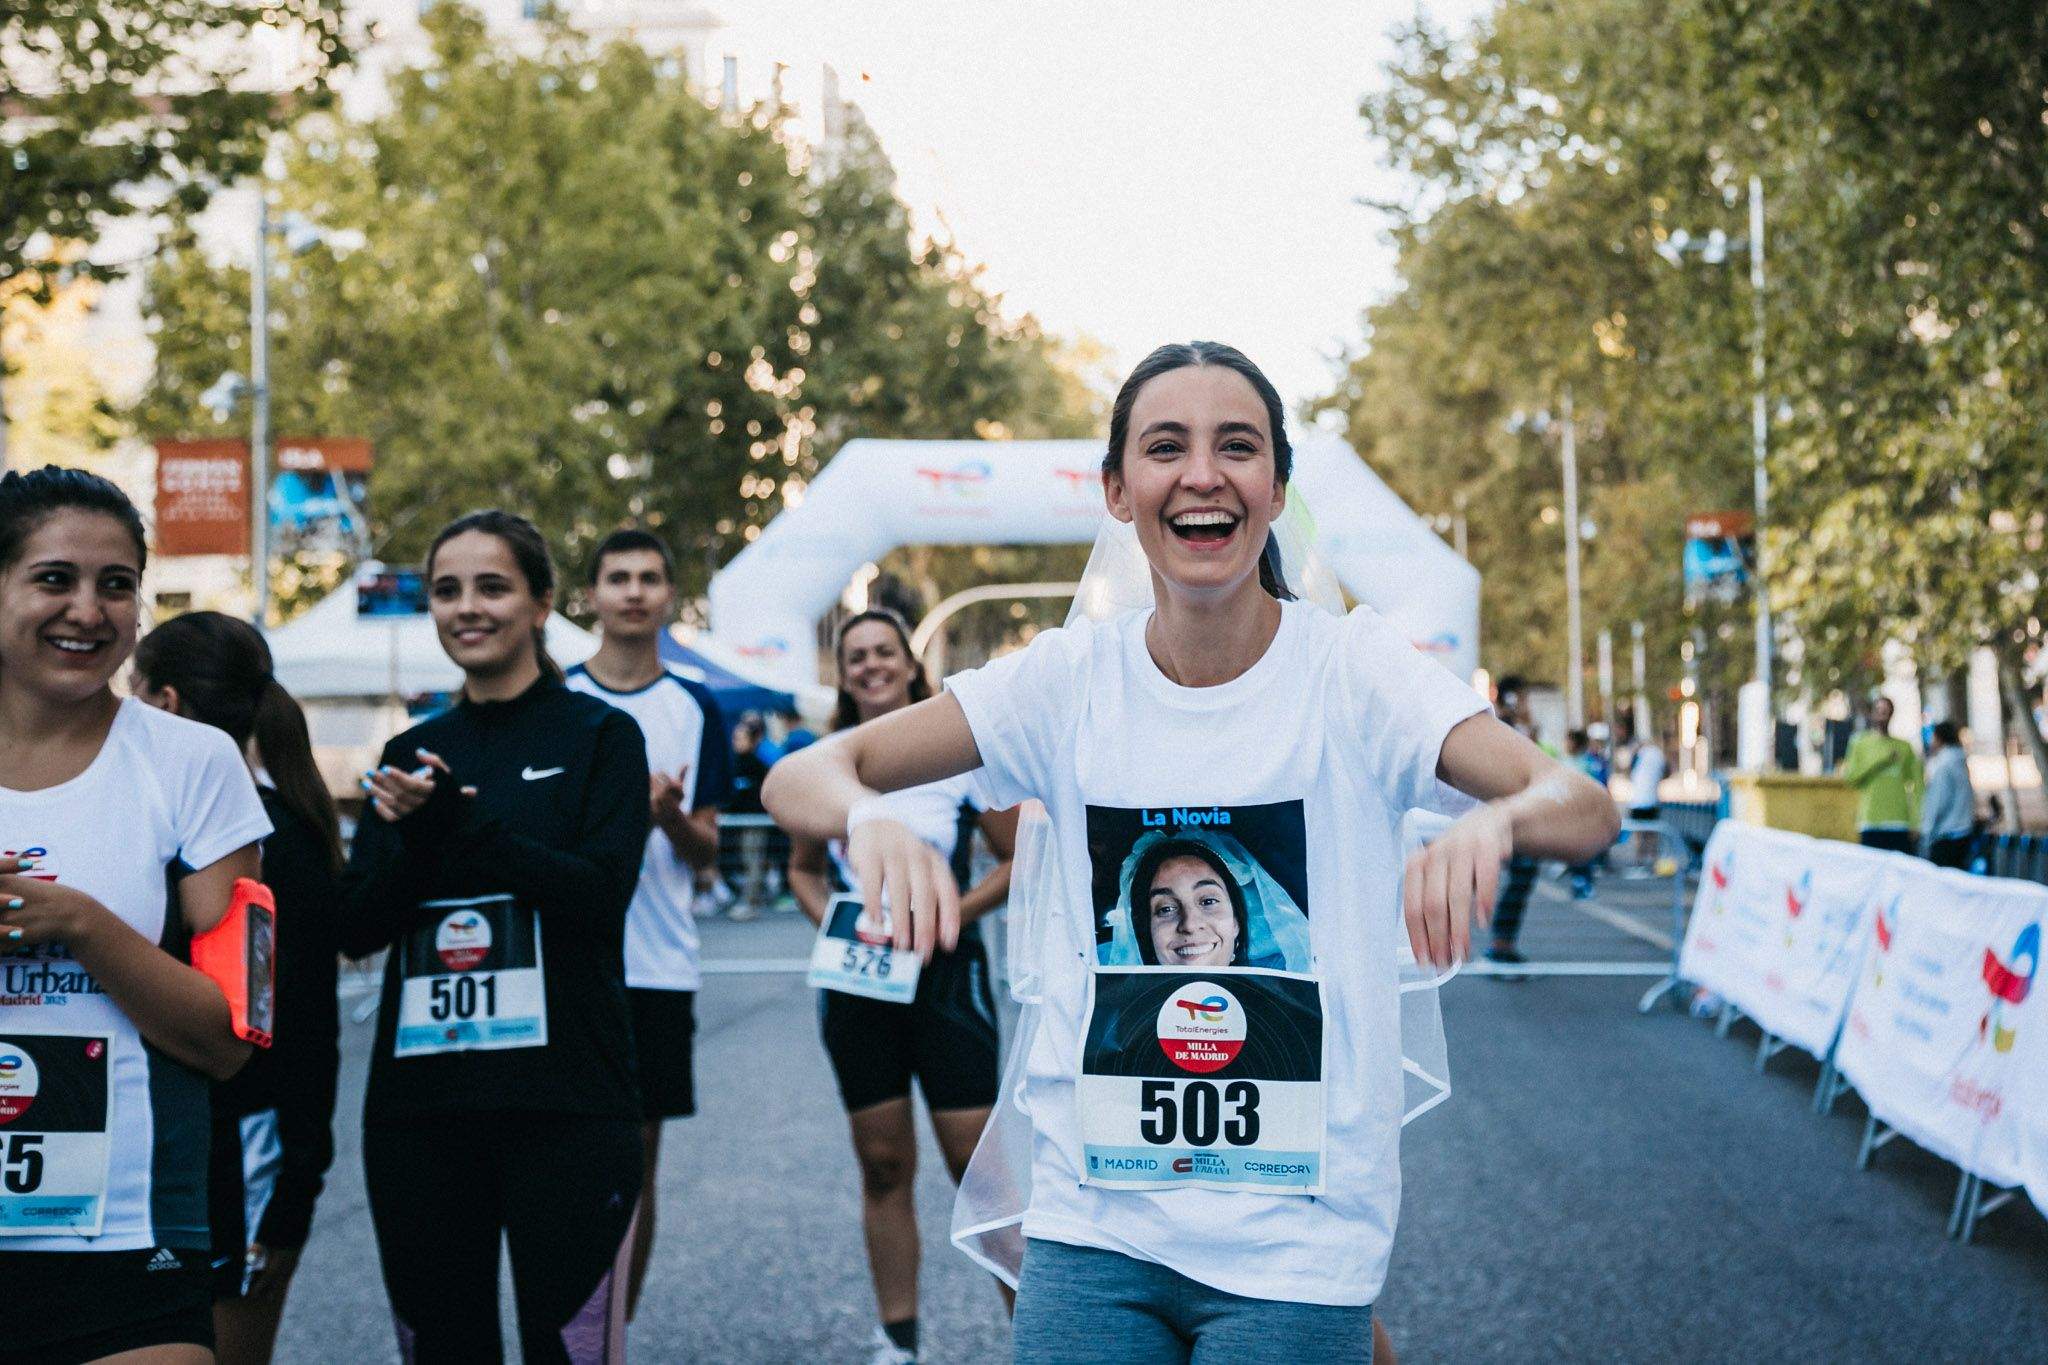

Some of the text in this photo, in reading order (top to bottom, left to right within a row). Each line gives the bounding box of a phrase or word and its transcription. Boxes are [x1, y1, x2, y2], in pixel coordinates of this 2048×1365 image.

[1142, 806, 1231, 827] La Novia
[431, 974, 496, 1021] 501
[1175, 1025, 1229, 1035] TotalEnergies
[1187, 1042, 1217, 1051] MILLA
[1175, 1051, 1229, 1061] DE MADRID
[1140, 1080, 1261, 1147] 503
[0, 1135, 44, 1193] 5
[1104, 1158, 1159, 1171] MADRID
[1194, 1157, 1226, 1166] MILLA
[1194, 1165, 1231, 1176] URBANA
